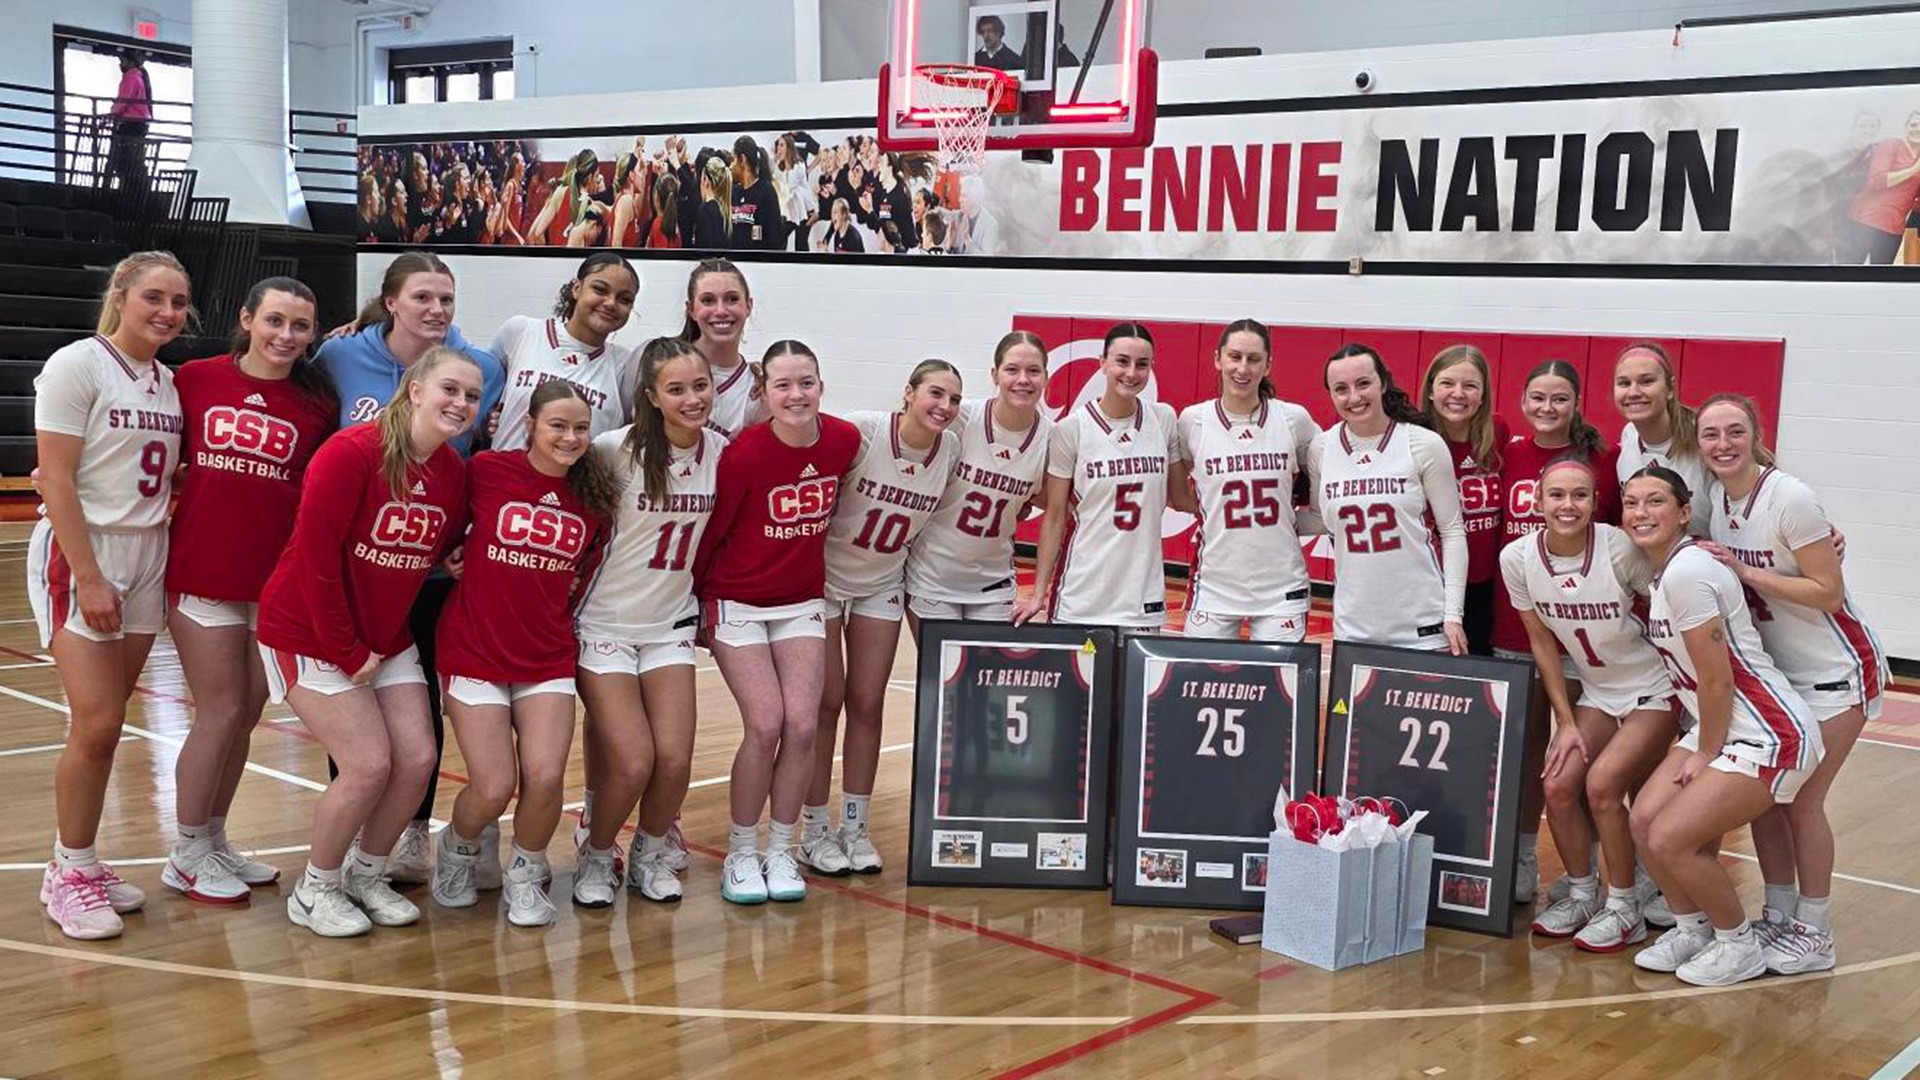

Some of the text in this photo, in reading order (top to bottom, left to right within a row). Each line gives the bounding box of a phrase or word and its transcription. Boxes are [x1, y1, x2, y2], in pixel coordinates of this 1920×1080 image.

[1059, 128, 1739, 232] BENNIE NATION
[516, 370, 534, 387] ST.
[109, 409, 134, 429] ST.
[204, 405, 298, 464] CSB
[138, 440, 168, 497] 9
[956, 462, 1033, 496] ST. BENEDICT
[1086, 457, 1165, 479] ST. BENEDICT
[1205, 453, 1289, 476] ST. BENEDICT
[767, 475, 838, 523] CSB
[857, 478, 939, 513] ST. BENEDICT
[1113, 482, 1143, 531] 5
[1221, 478, 1280, 529] 25
[1326, 478, 1407, 500] ST. BENEDICT
[371, 501, 447, 551] CSB
[496, 501, 587, 560] CSB
[852, 508, 911, 554] 10
[956, 491, 1009, 538] 21
[1338, 502, 1402, 554] 22
[649, 520, 697, 571] 11
[1554, 602, 1620, 620] BENEDICT
[1574, 628, 1606, 667] 1
[977, 669, 1061, 688] ST. BENEDICT
[1182, 681, 1266, 701] ST. BENEDICT
[1384, 689, 1473, 714] ST. BENEDICT
[1006, 695, 1028, 745] 5
[1195, 707, 1246, 757] 25
[1398, 716, 1449, 772] 22
